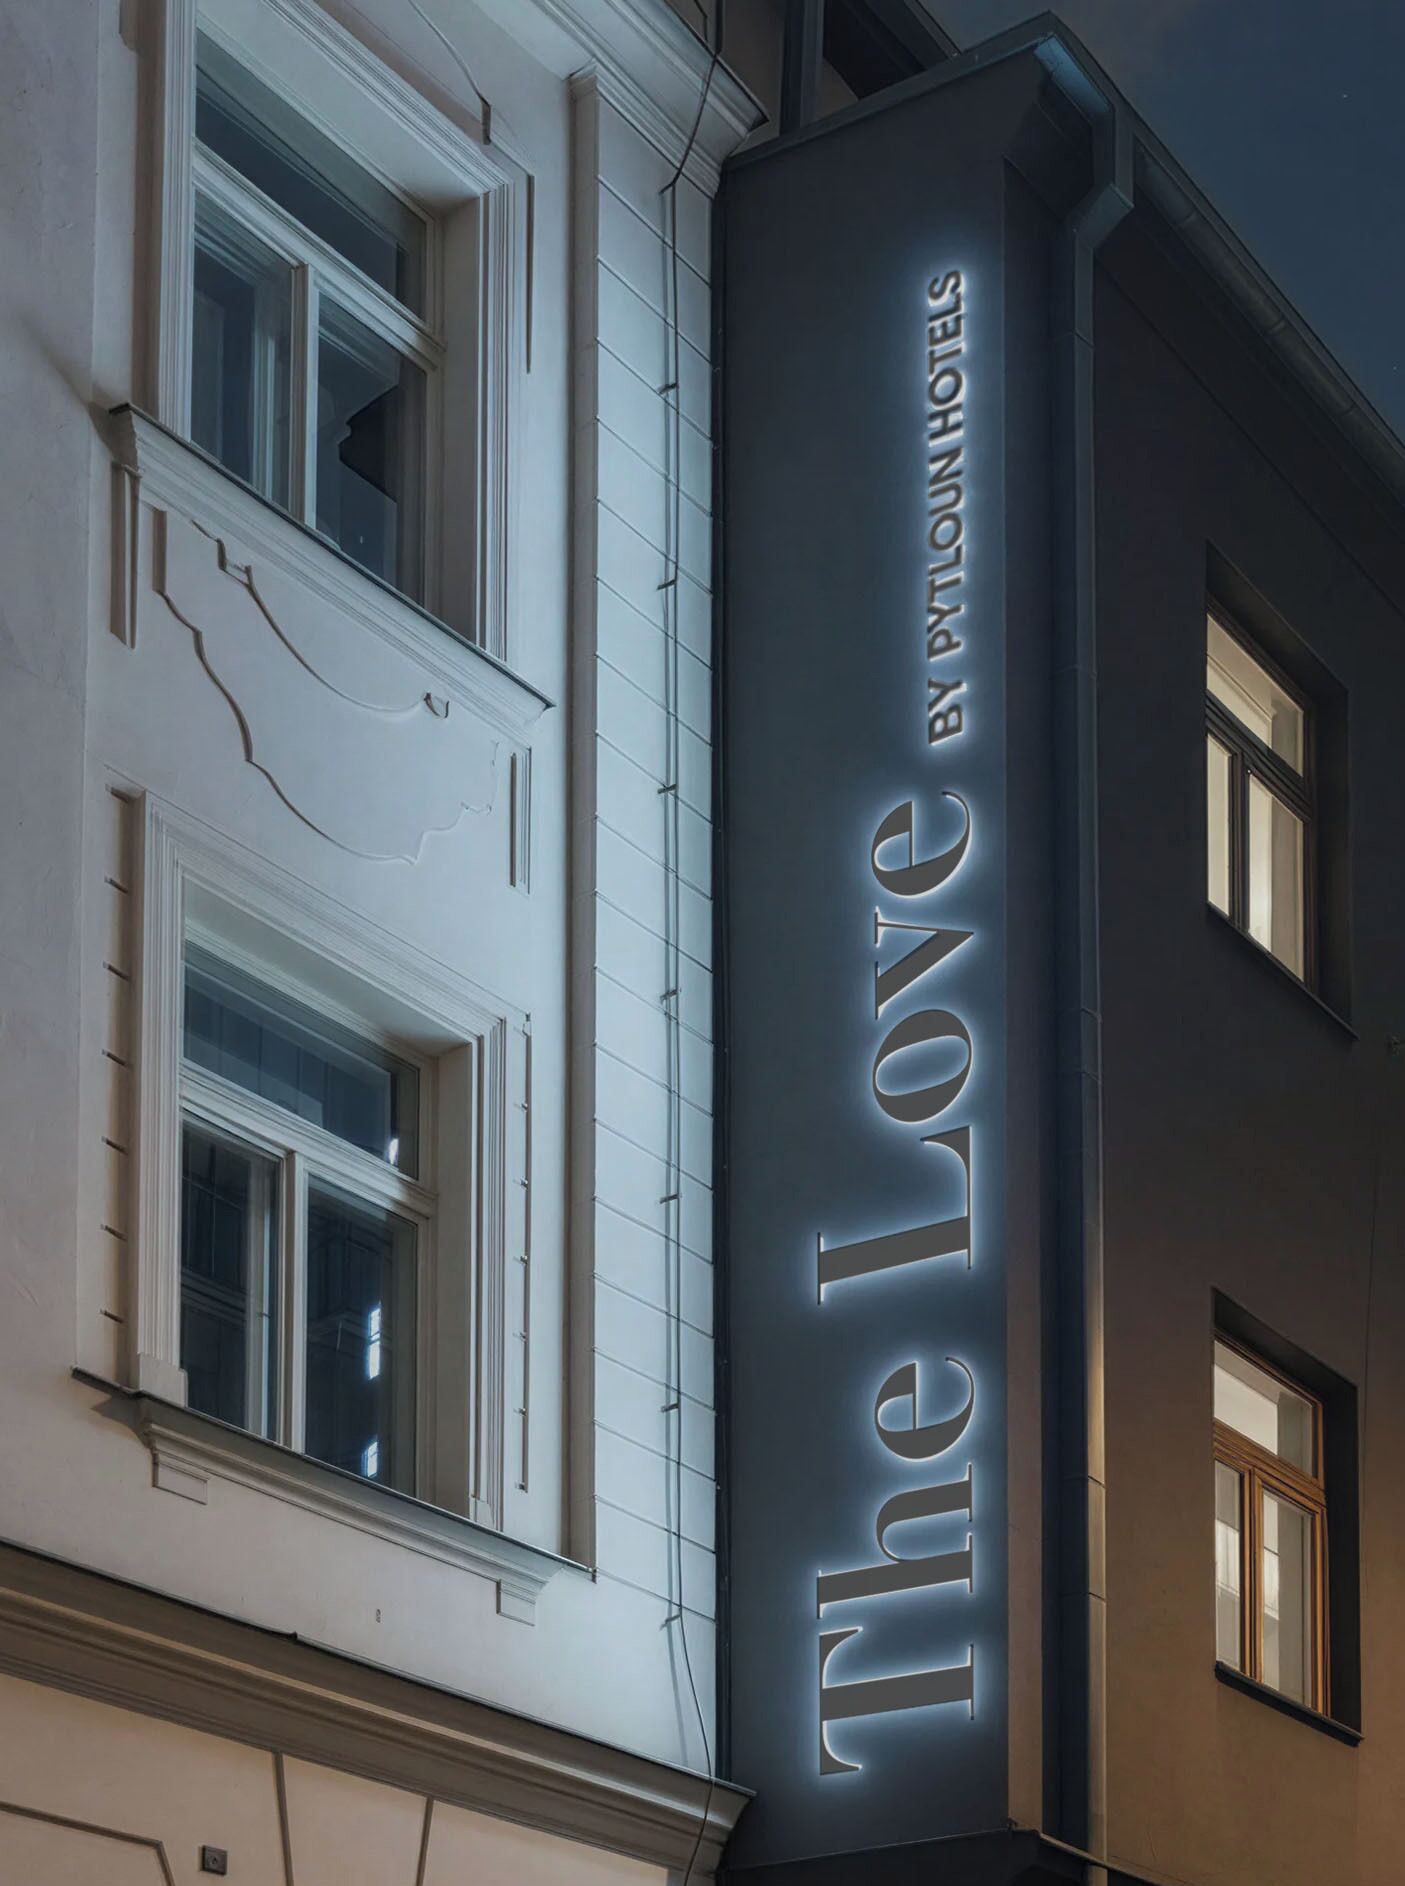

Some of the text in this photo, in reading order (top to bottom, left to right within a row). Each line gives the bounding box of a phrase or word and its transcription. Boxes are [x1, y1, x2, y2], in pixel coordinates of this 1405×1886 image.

[817, 268, 975, 1776] The Love BY PYTLOUN HOTELS
